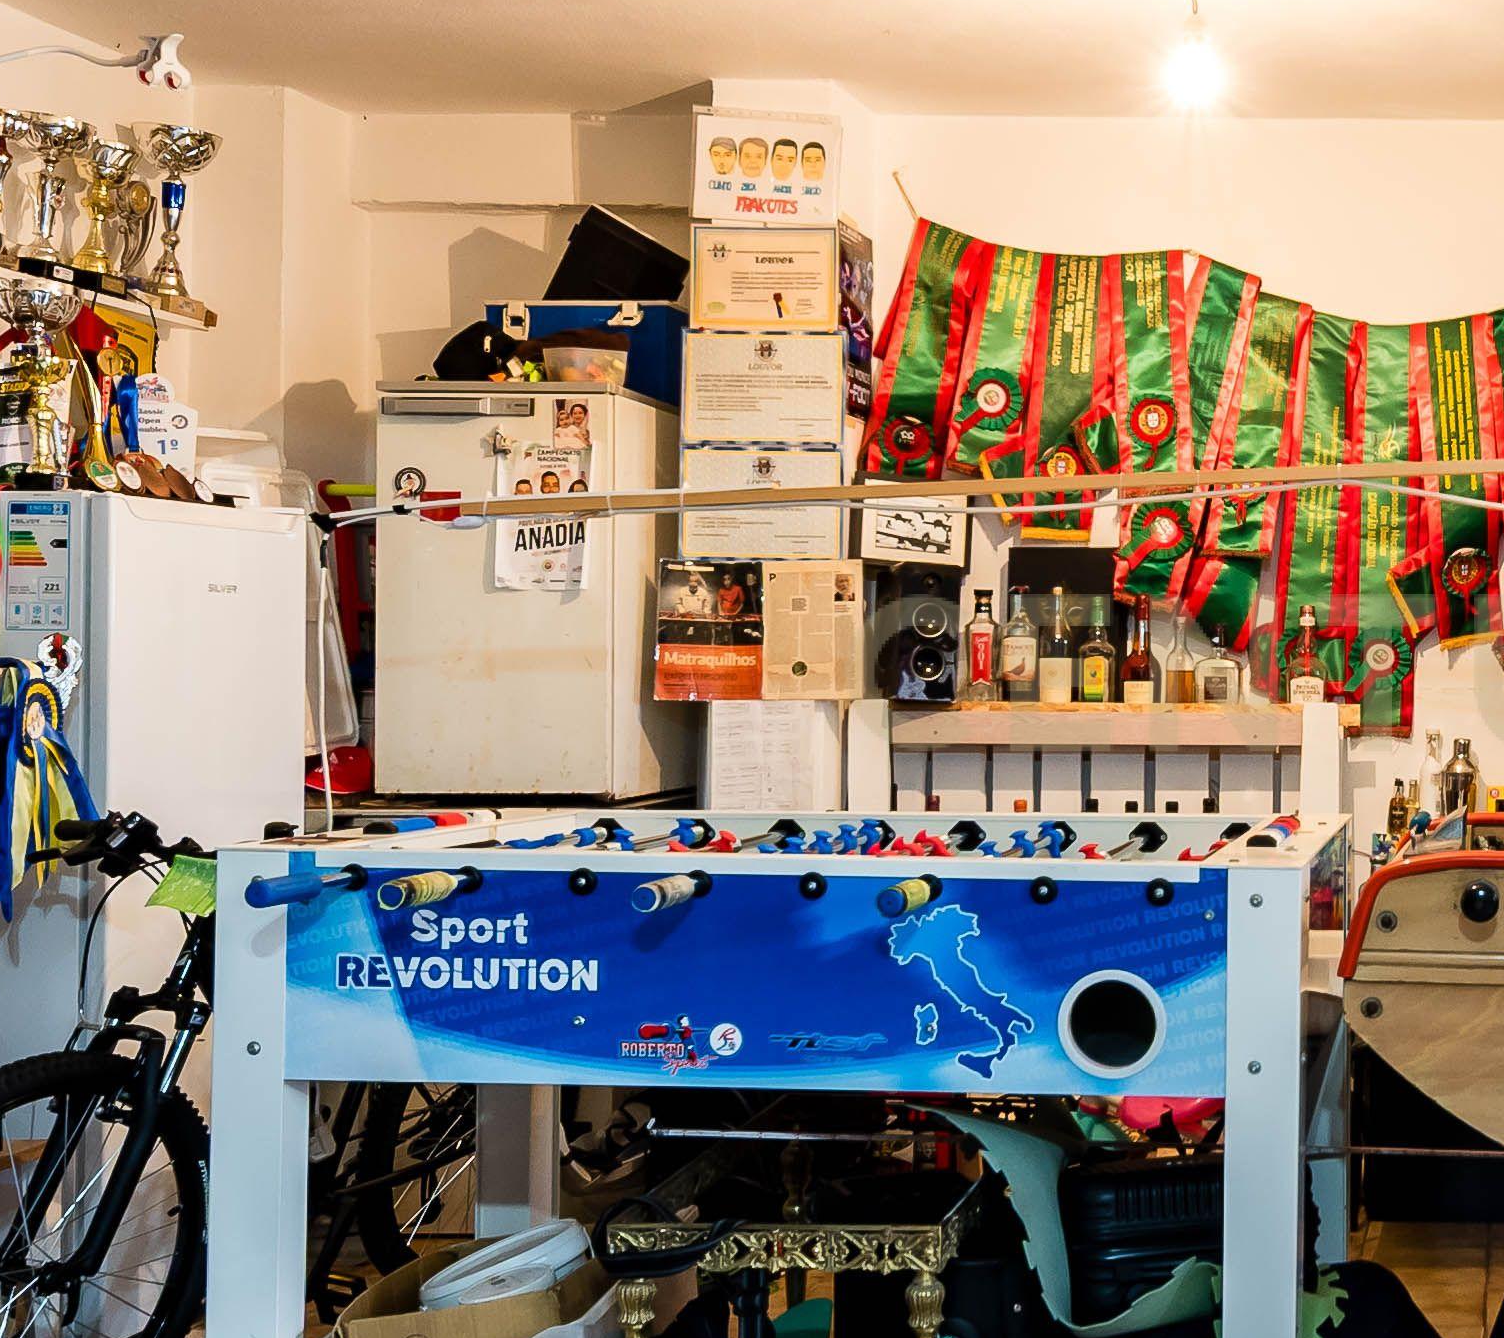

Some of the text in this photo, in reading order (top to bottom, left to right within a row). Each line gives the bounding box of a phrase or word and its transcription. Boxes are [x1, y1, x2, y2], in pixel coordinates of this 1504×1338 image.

[157, 438, 179, 456] 1º
[515, 521, 586, 552] ANADIA
[44, 582, 61, 592] 221
[207, 583, 238, 594] SILVER
[663, 651, 757, 669] Matraquilhos
[410, 908, 530, 950] Sport
[621, 1041, 687, 1059] ROBERTO
